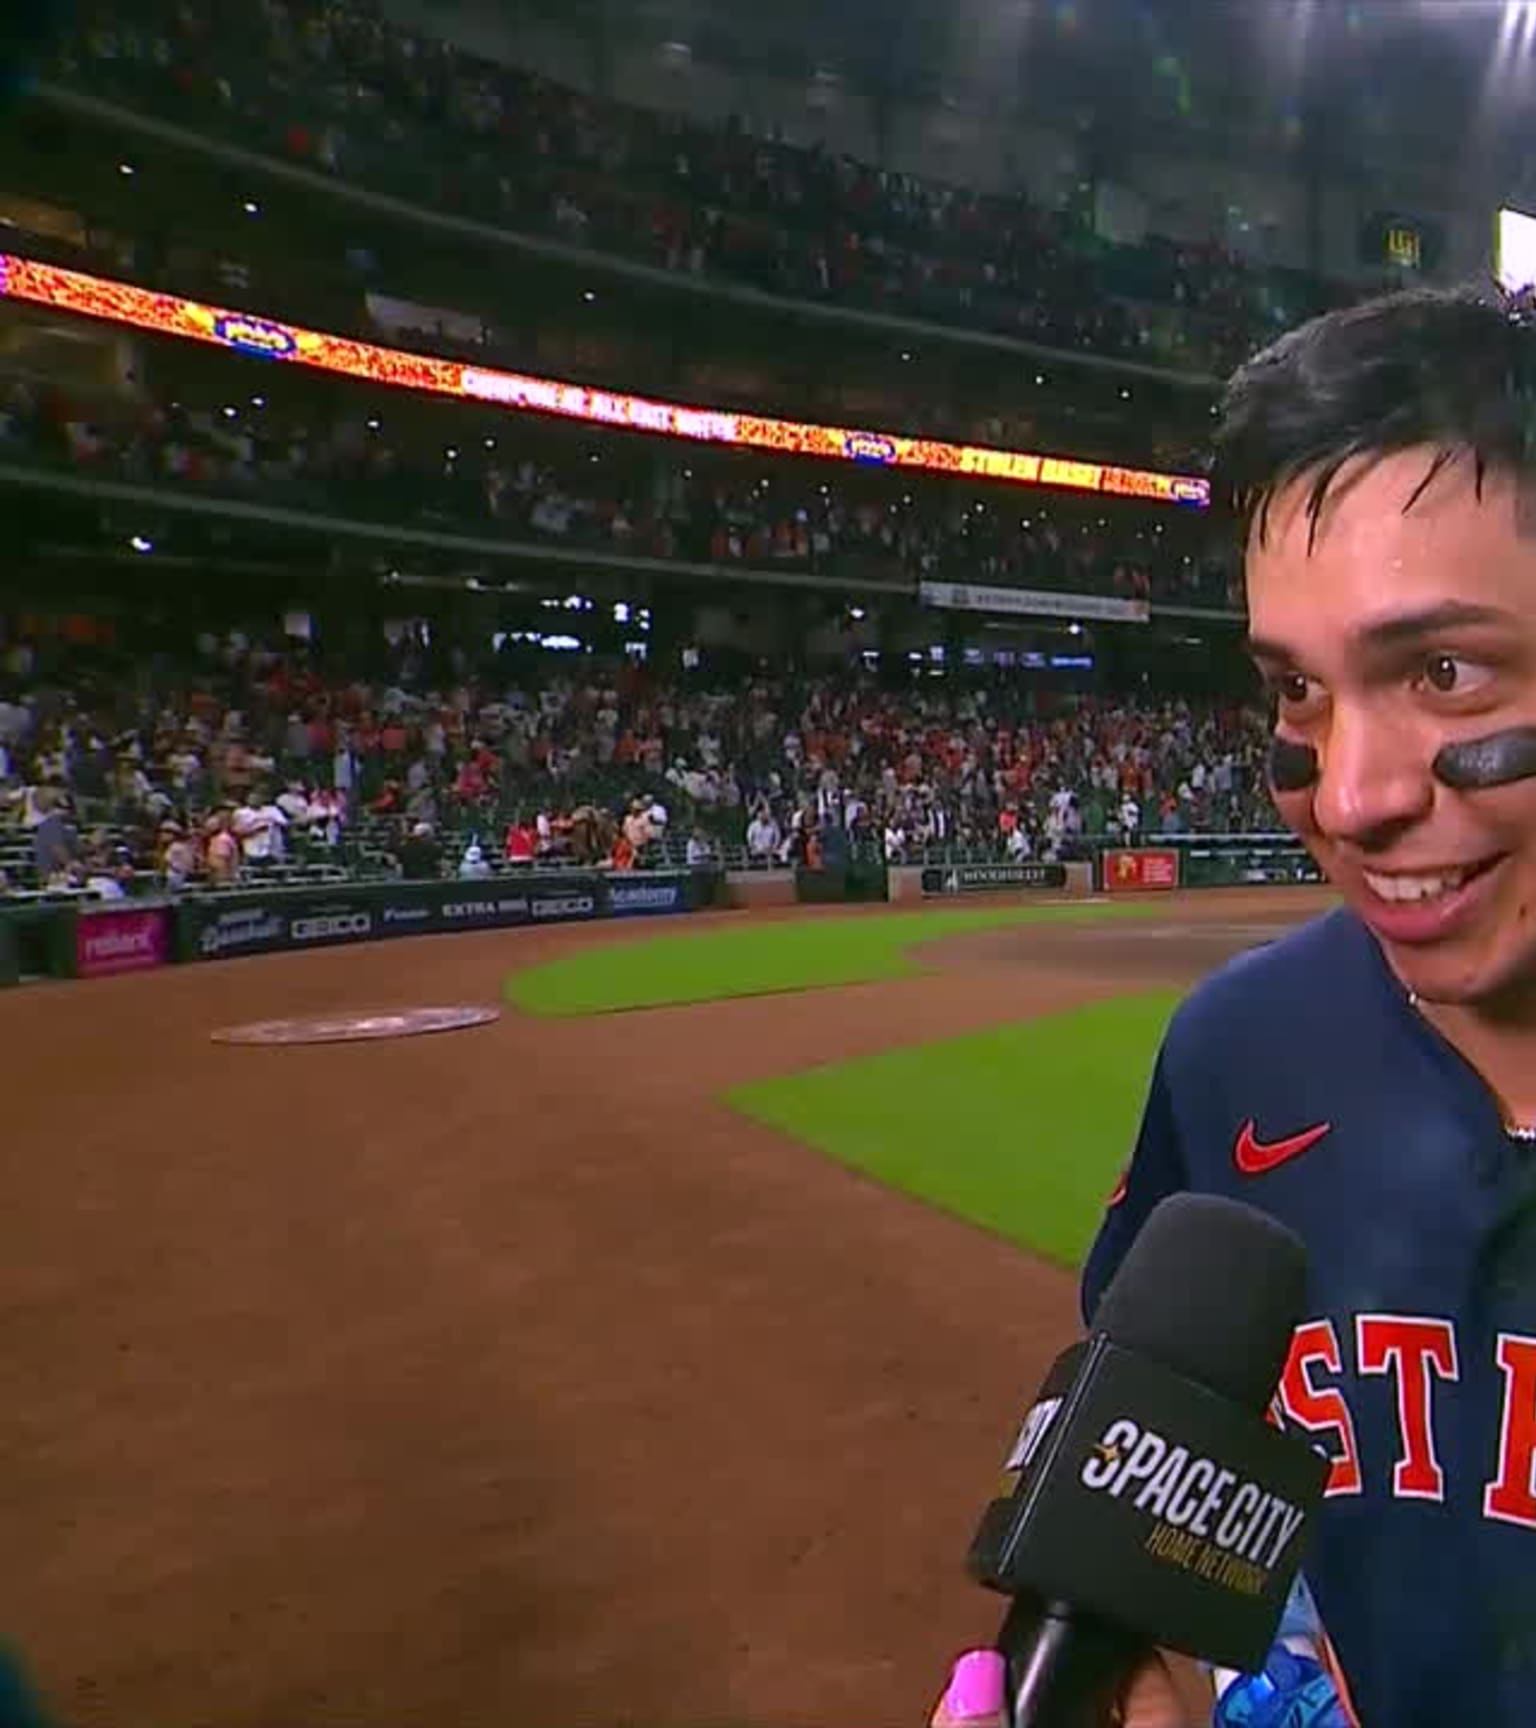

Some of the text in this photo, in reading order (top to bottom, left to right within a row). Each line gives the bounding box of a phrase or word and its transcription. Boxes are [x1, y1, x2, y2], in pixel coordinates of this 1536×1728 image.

[442, 902, 496, 917] EXTRA
[532, 897, 595, 917] GEICO
[291, 913, 370, 940] GEICO
[1081, 1418, 1236, 1536] SPACE
[1215, 1483, 1304, 1569] CITY
[1145, 1522, 1270, 1595] HOME NETWORK
